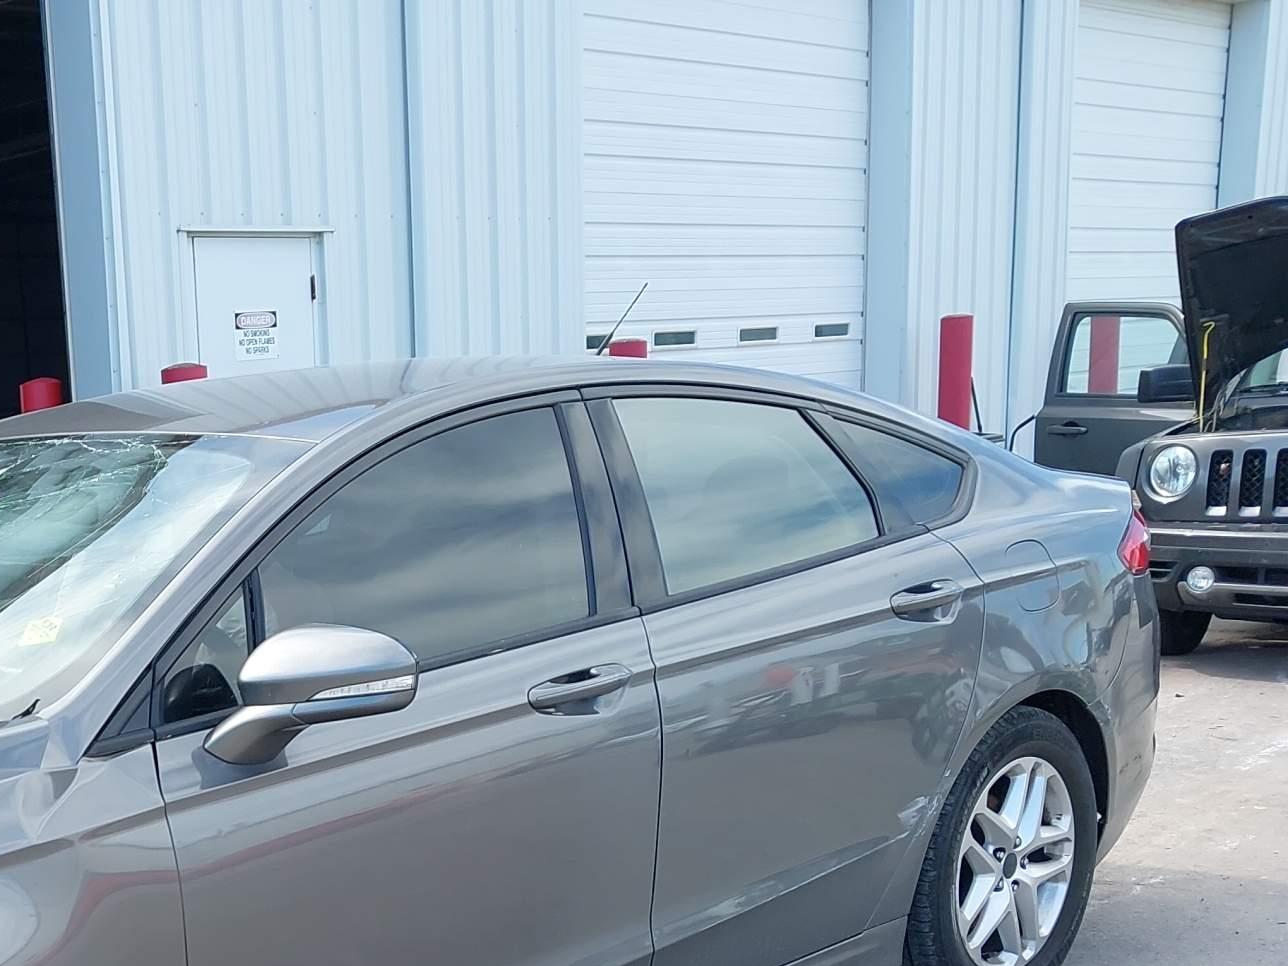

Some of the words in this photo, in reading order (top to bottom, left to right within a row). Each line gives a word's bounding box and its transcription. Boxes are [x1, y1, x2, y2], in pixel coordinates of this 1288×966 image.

[241, 316, 271, 325] DANGER
[243, 330, 250, 338] NO
[251, 329, 269, 337] SMOKING
[246, 338, 257, 346] OPEN
[259, 337, 275, 345] FLAMES
[253, 346, 269, 354] SPARKS
